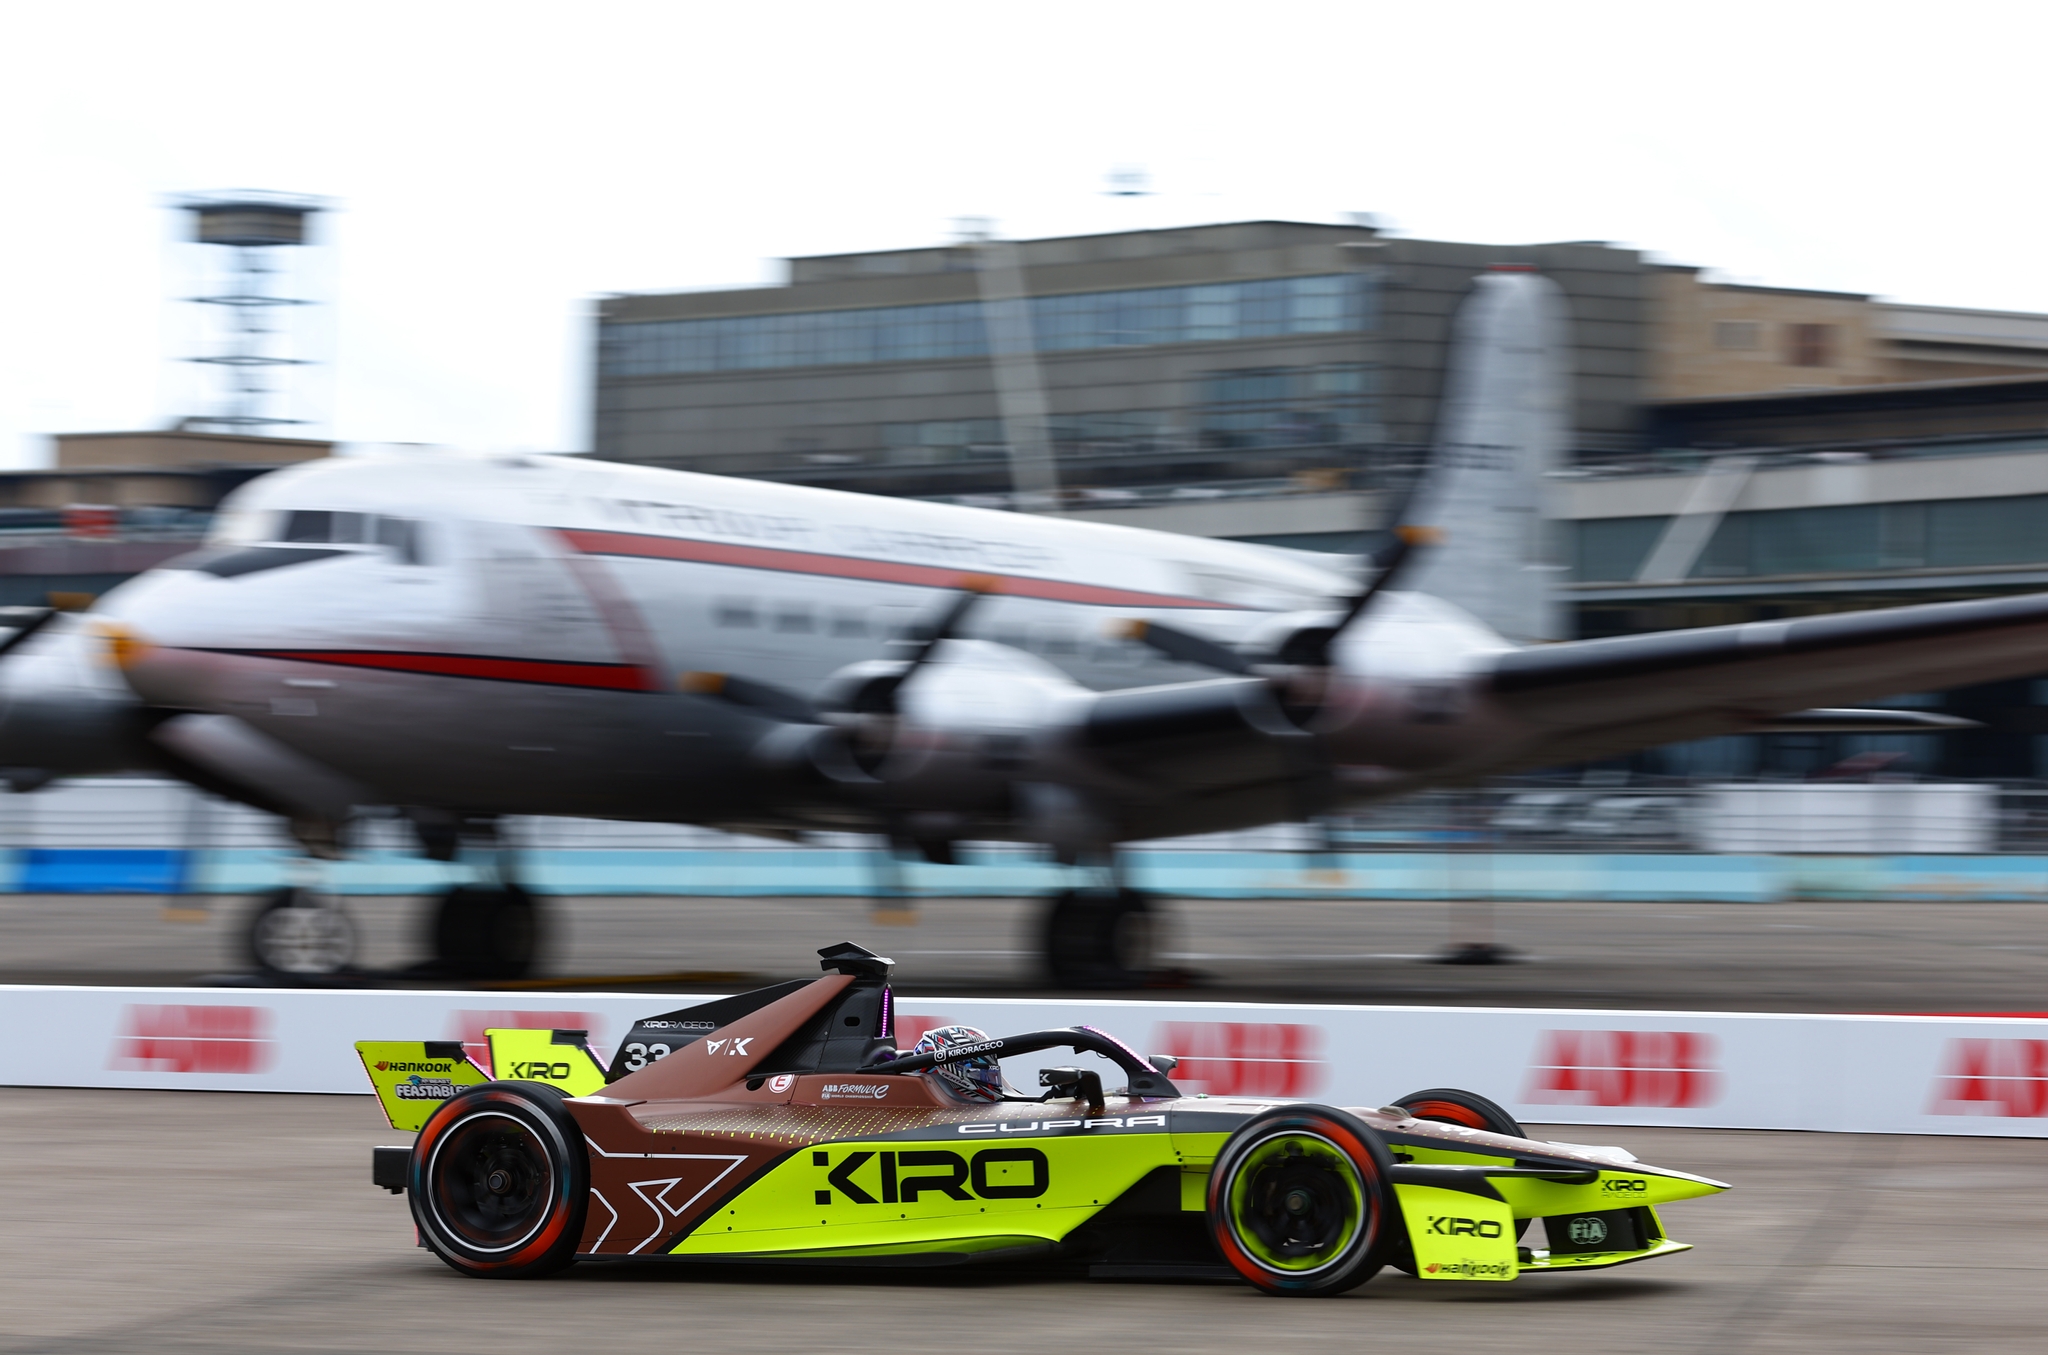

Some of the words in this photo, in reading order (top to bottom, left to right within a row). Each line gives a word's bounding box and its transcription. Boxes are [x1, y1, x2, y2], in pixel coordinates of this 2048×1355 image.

[948, 1040, 1004, 1058] KIRORACECO
[509, 1062, 571, 1080] KIRO
[1515, 1028, 1730, 1110] ABB
[822, 1084, 838, 1093] ABB
[838, 1084, 875, 1094] FORMULA
[957, 1115, 1166, 1134] CUPRA
[812, 1147, 1049, 1206] KIRO
[1601, 1180, 1647, 1192] KIRO
[1427, 1215, 1502, 1239] KIRO
